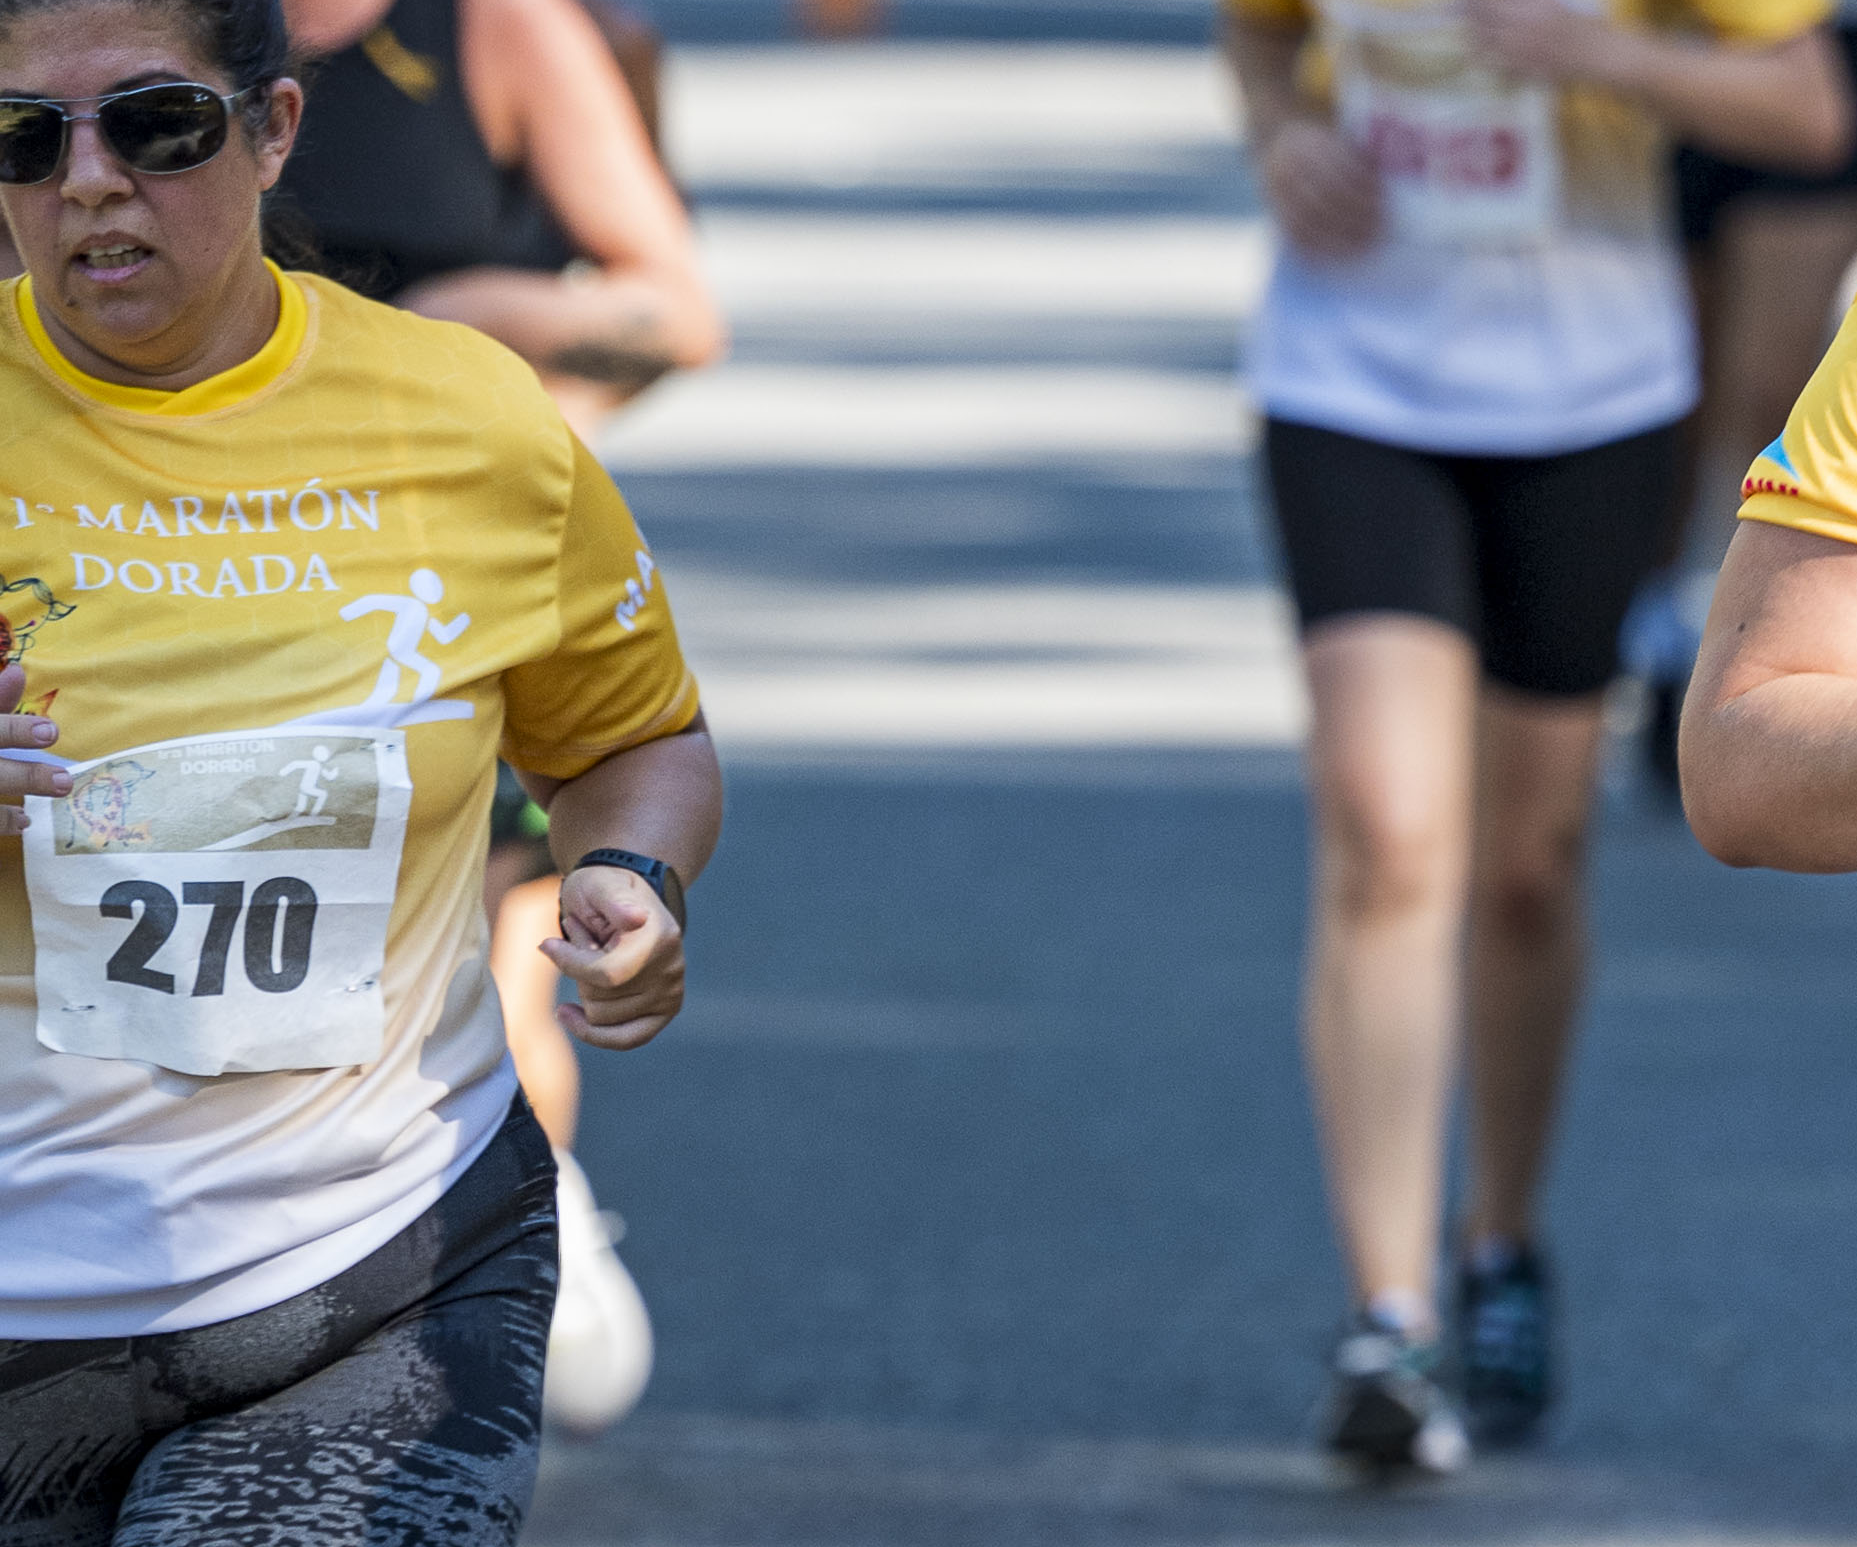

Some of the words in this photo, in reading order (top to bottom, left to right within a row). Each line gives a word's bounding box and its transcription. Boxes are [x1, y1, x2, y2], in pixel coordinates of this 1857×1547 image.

[73, 478, 380, 537] MARATÓN
[70, 553, 340, 598] DORADA
[100, 876, 318, 997] 270
